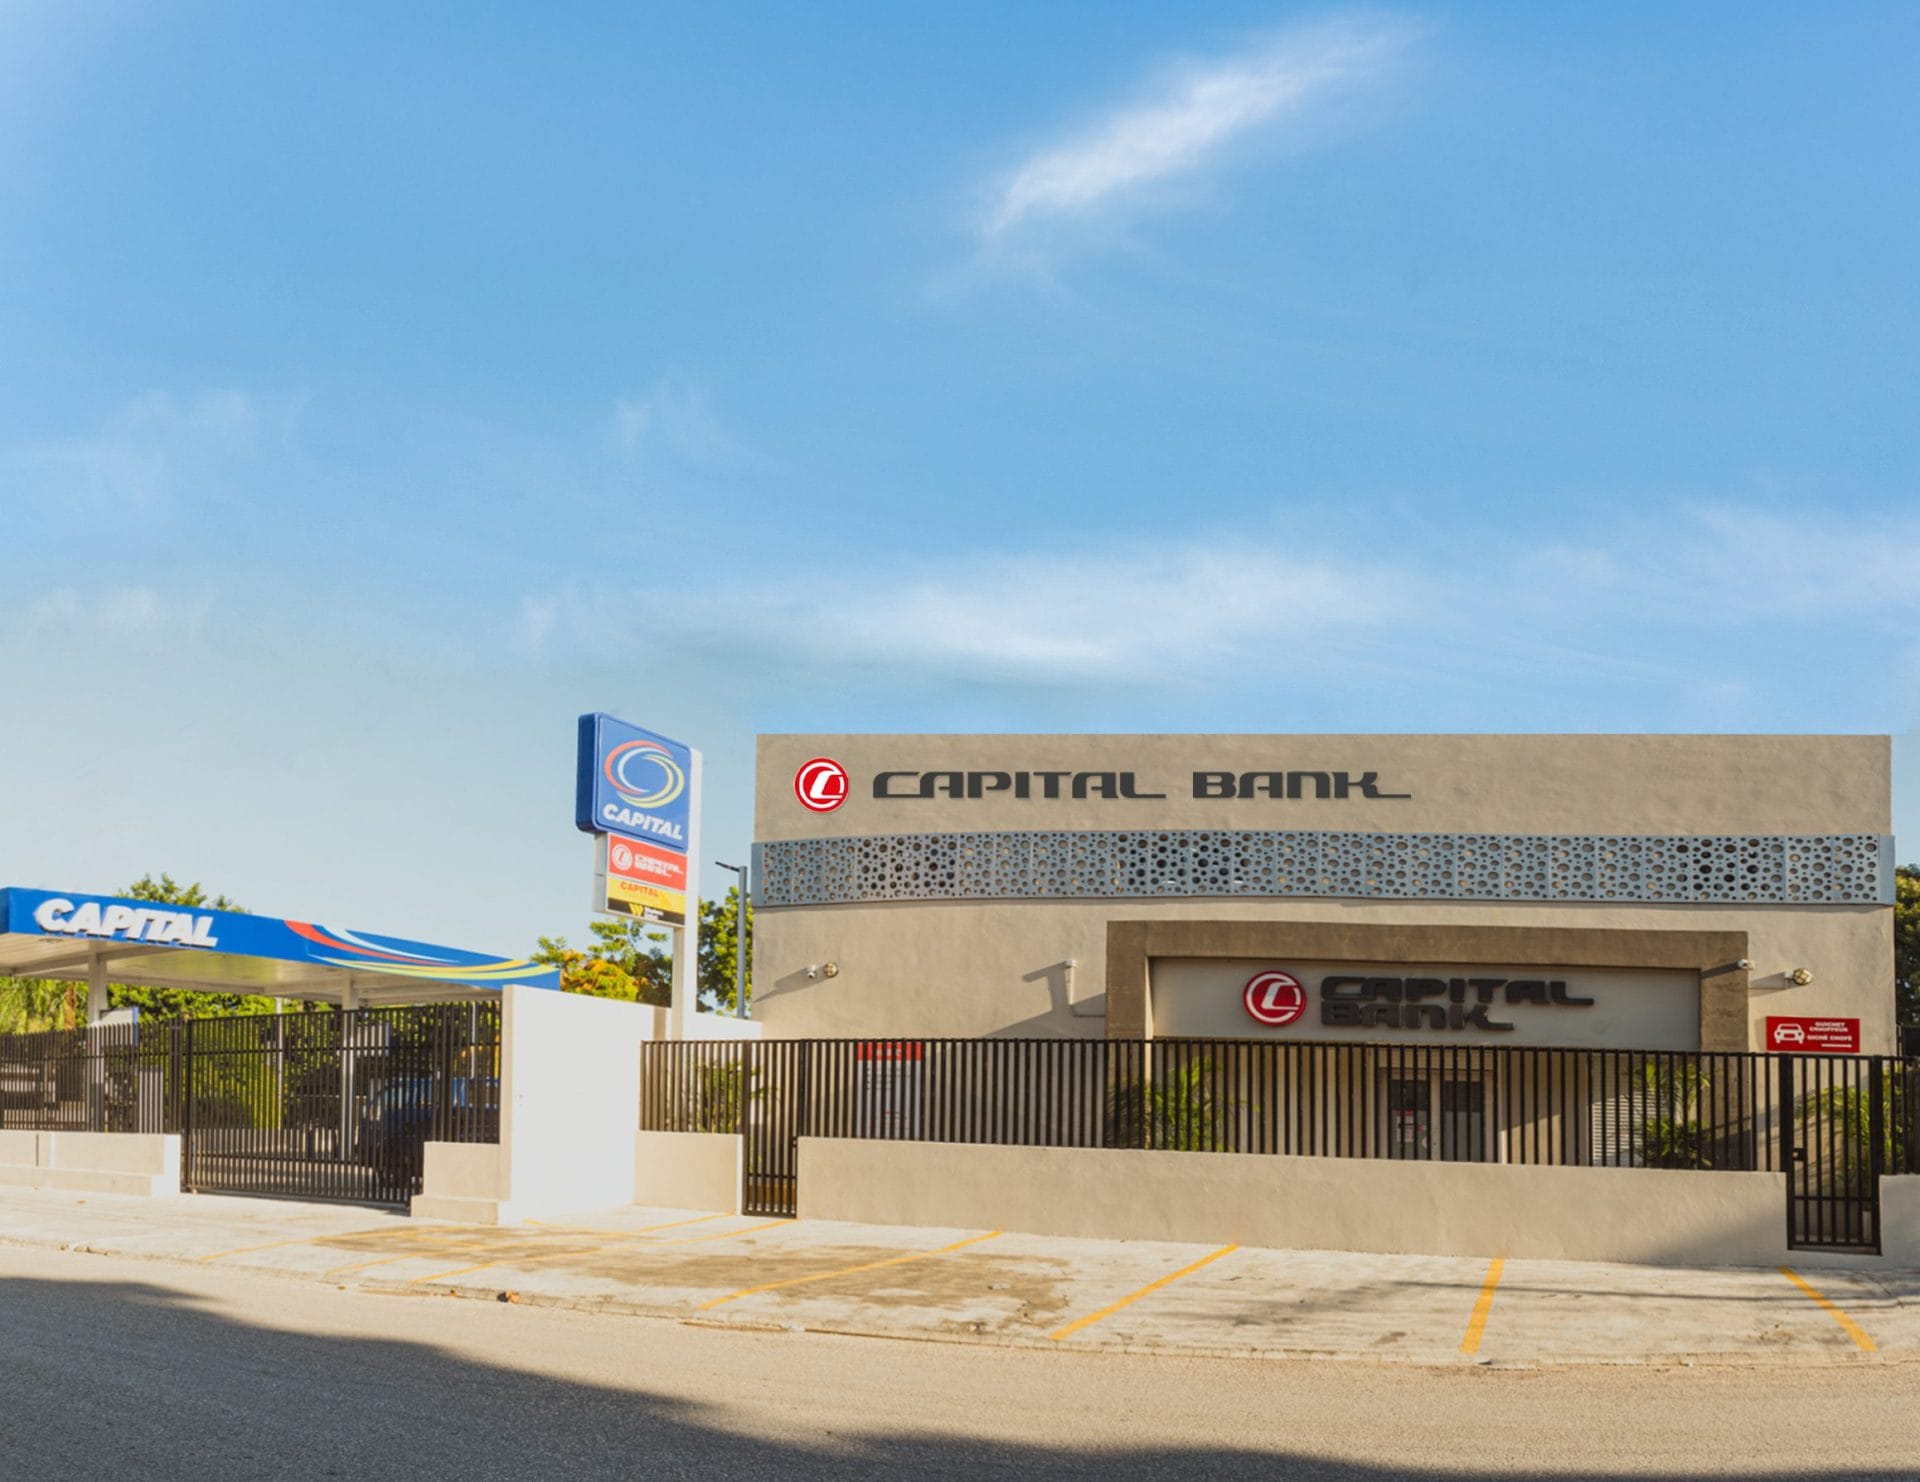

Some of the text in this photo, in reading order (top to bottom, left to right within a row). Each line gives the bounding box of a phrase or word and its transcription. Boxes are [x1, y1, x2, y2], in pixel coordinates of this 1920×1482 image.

[872, 771, 1412, 799] CAPITAL BANK
[602, 803, 683, 840] CAPITAL
[620, 881, 659, 897] CAPITAL
[34, 898, 218, 948] CAPITAL
[1320, 975, 1595, 1006] CAPITAL
[1320, 1000, 1515, 1031] BANK
